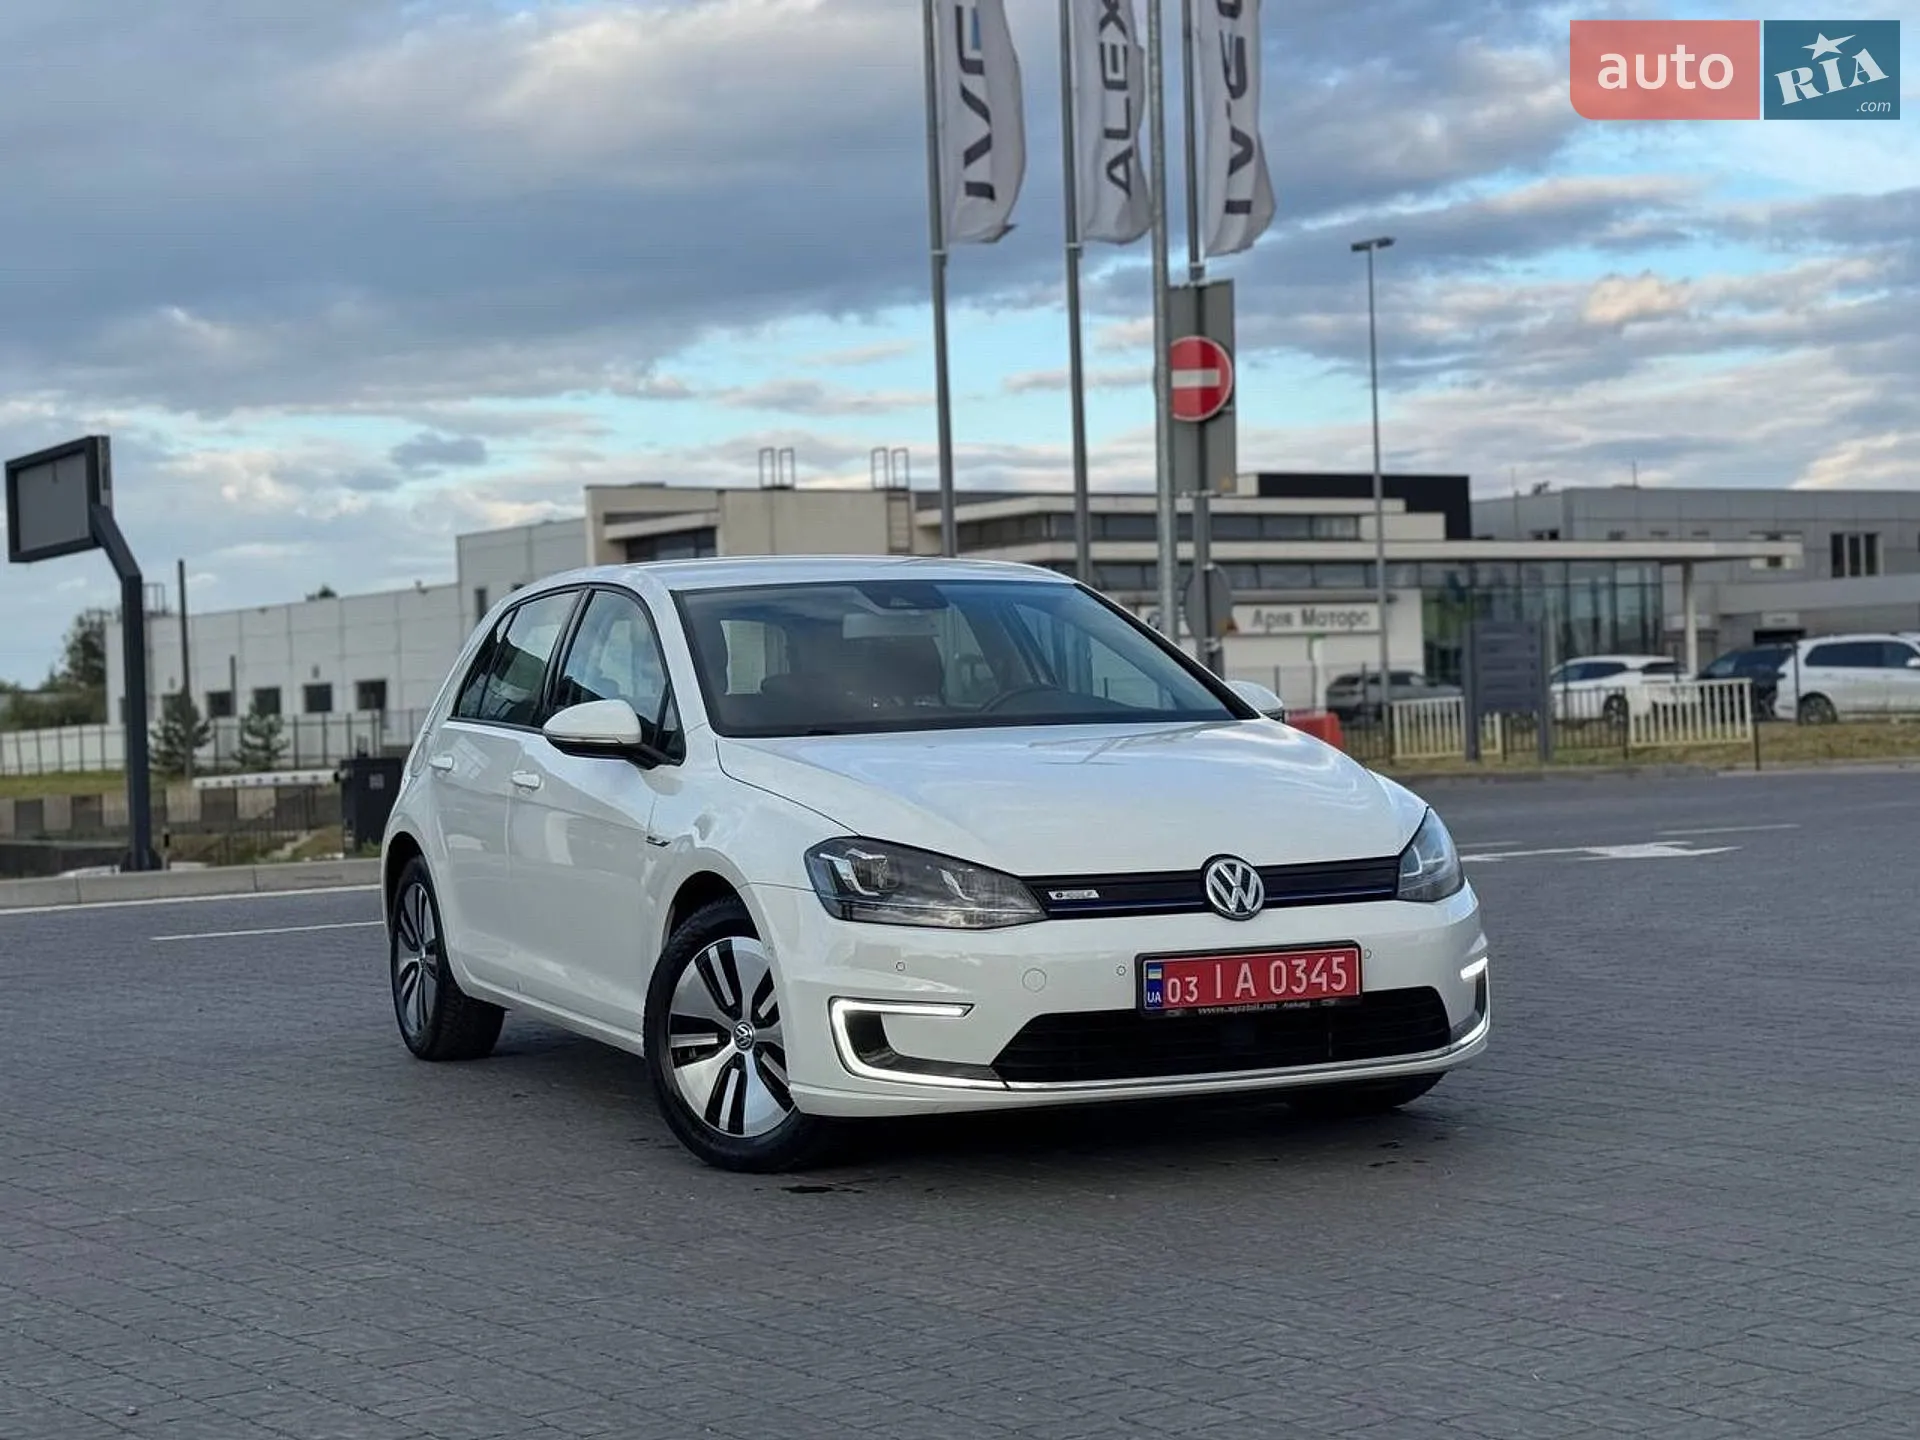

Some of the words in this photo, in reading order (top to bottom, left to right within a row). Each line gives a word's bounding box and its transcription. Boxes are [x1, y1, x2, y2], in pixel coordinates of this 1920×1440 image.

[1167, 977, 1199, 1003] 03
[1269, 956, 1347, 995] 0345
[1146, 991, 1162, 1004] UA
